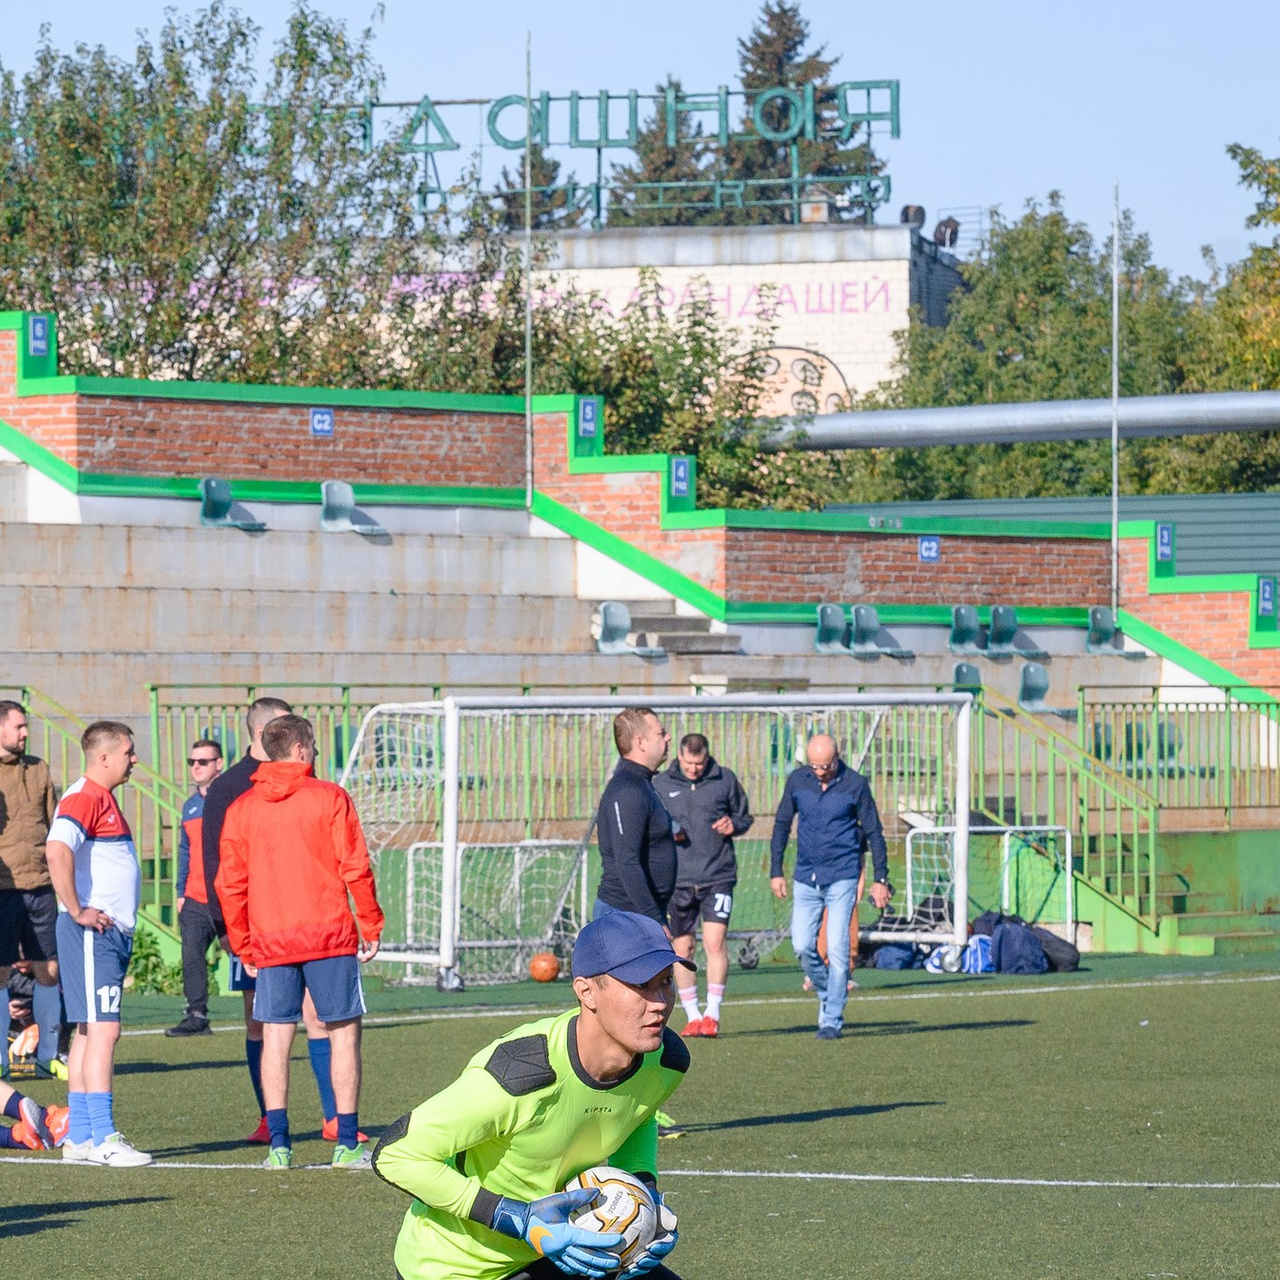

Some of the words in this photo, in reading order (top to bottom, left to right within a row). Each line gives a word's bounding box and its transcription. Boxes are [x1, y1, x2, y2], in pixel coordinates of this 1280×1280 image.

[584, 405, 593, 419] 5
[96, 985, 120, 1013] 12
[607, 1190, 624, 1214] TORRES
